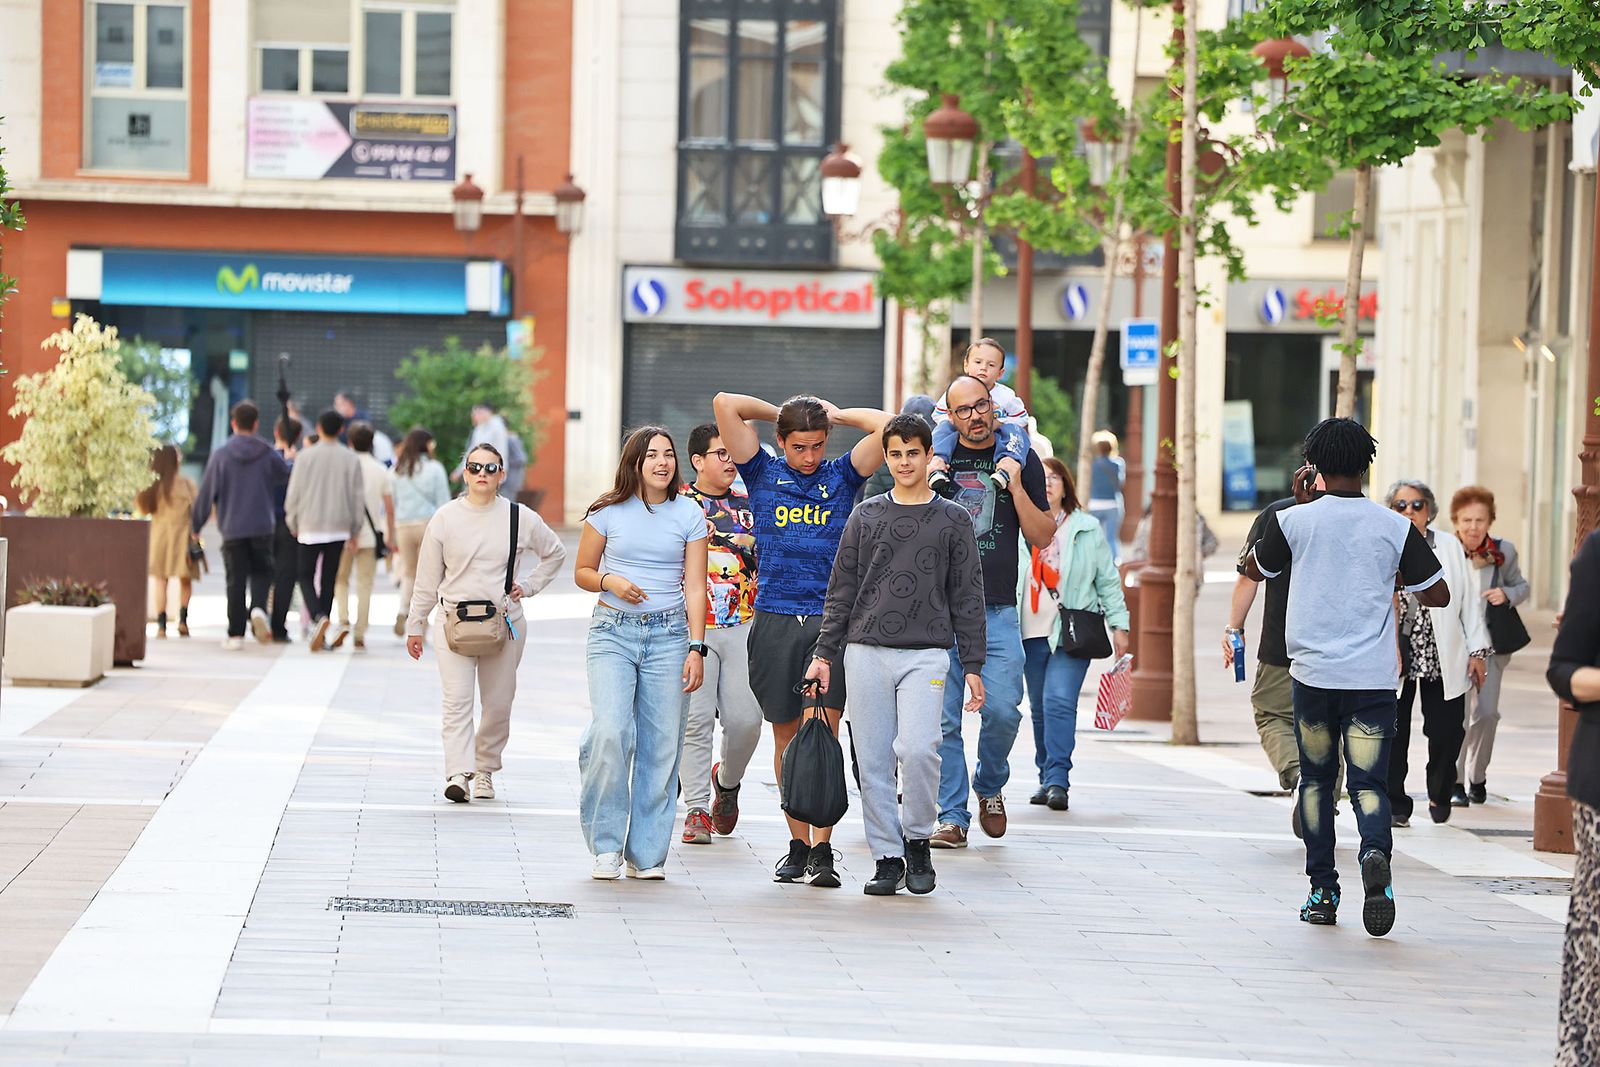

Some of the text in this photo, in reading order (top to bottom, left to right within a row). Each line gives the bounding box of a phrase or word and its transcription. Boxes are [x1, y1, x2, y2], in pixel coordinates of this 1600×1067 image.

[261, 271, 353, 294] movistar
[684, 278, 874, 319] Soloptical
[774, 504, 832, 527] getir
